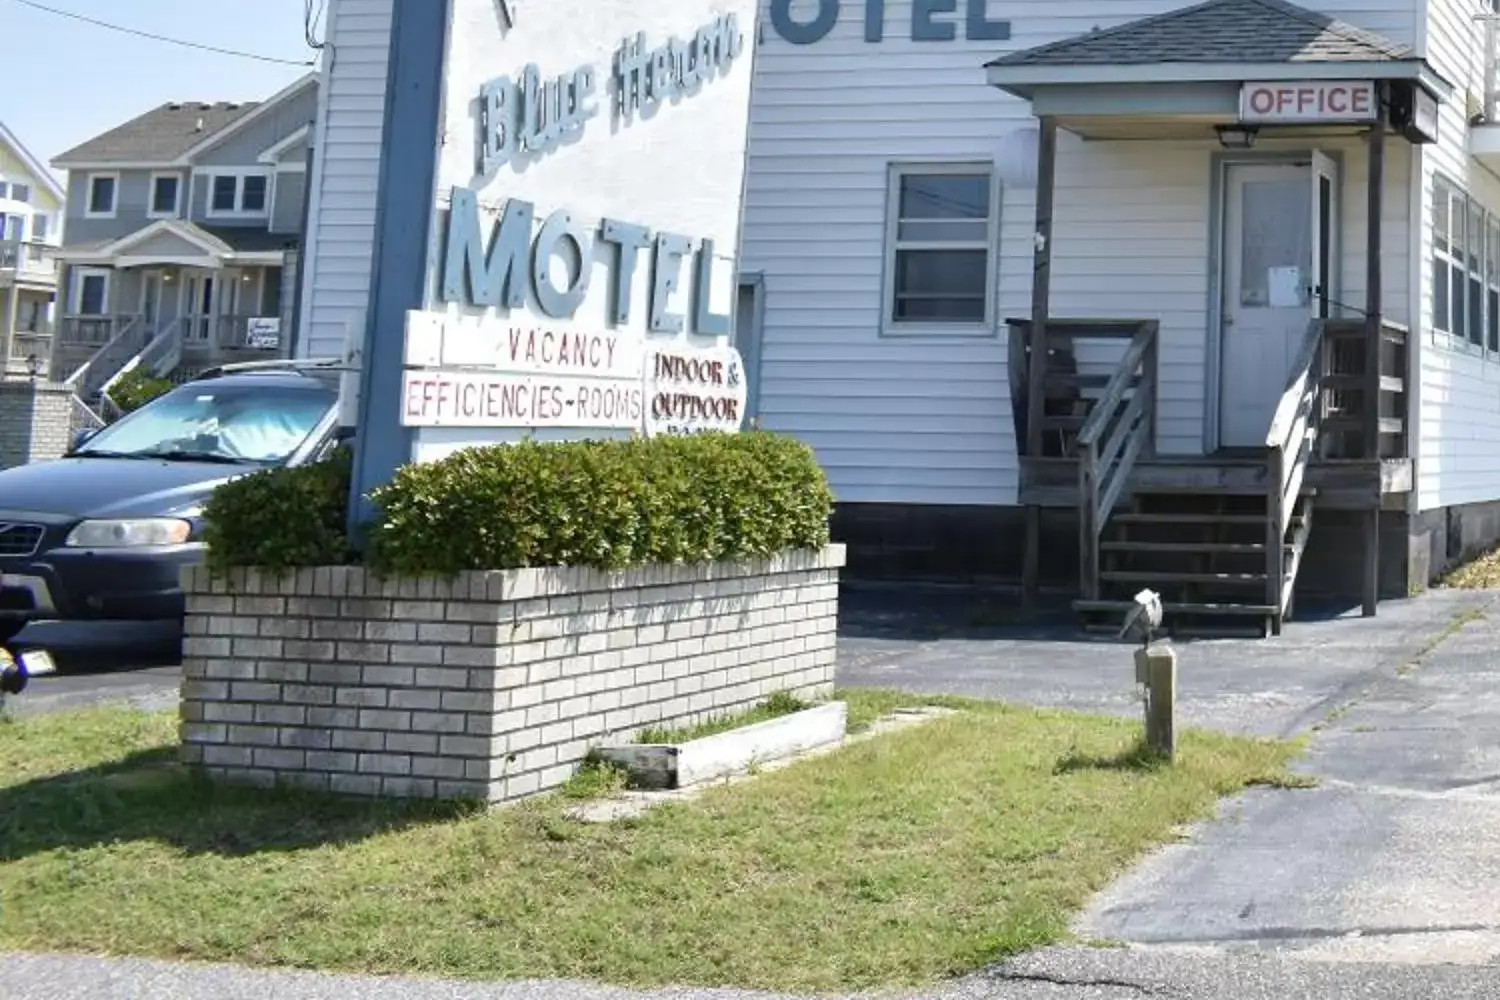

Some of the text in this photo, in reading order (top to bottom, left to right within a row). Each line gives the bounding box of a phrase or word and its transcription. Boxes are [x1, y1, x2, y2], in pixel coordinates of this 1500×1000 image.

[478, 12, 744, 176] Blue Heron
[1250, 87, 1369, 114] OFFICE
[443, 185, 731, 335] MOTEL
[508, 327, 617, 370] VACANCY
[655, 351, 739, 387] INDOOR &
[651, 391, 738, 421] OUTDOOR
